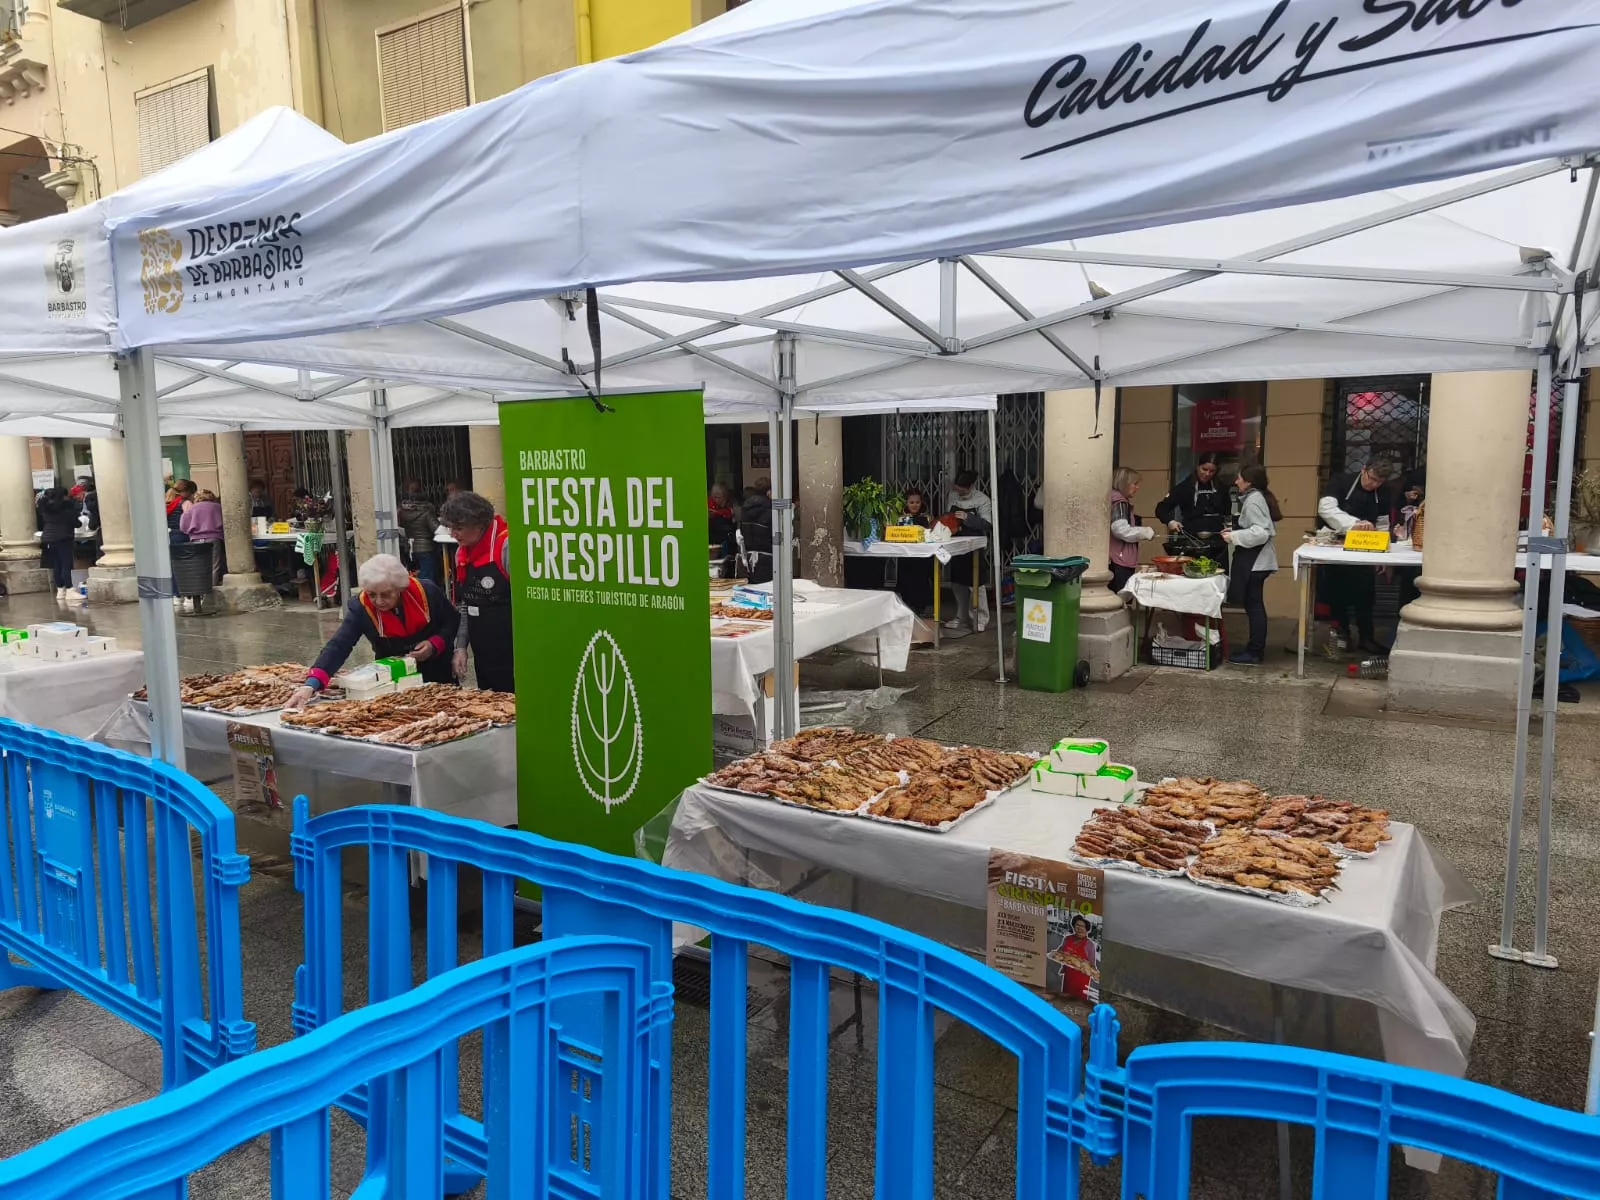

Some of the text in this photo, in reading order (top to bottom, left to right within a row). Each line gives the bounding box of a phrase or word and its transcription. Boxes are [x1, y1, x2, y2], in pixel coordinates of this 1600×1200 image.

[1023, 0, 1285, 128] Calidad
[1268, 17, 1339, 102] y
[185, 243, 304, 286] DE BARBASTRO
[192, 277, 304, 303] SOMONTANO
[47, 301, 87, 312] BARBASTRO
[519, 448, 586, 471] BARBASTRO
[521, 476, 684, 529] FIESTA DEL
[527, 531, 680, 588] CRESPILLO
[526, 586, 549, 600] FIESTA
[551, 588, 561, 602] DE
[563, 587, 594, 604] INTERÉS
[639, 594, 649, 608] DE
[651, 595, 685, 611] ARAGÓN
[1005, 871, 1056, 893] FIESTA
[997, 883, 1093, 915] CRESPILLO
[1003, 898, 1045, 917] BARBASTRO
